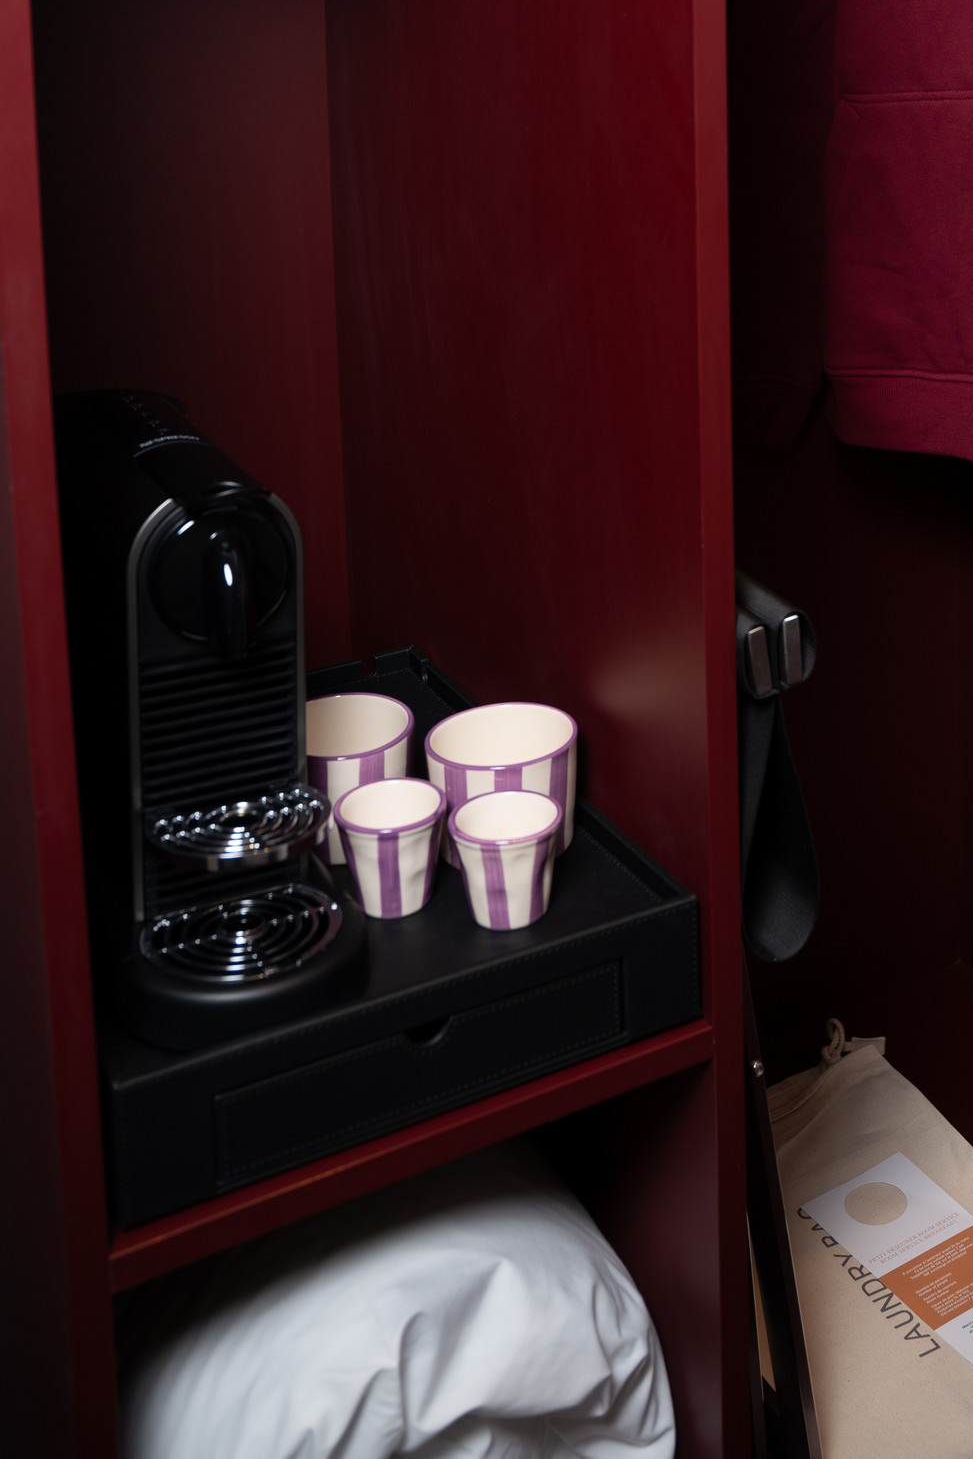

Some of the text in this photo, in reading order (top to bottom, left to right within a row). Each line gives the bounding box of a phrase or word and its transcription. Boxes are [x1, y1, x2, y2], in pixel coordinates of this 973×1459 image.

[879, 1219, 959, 1264] ROOM SERVICE BREAKFAST
[917, 1225, 936, 1237] ROOM
[934, 1212, 960, 1227] SERVICE
[833, 1253, 942, 1358] LAUNDRY
